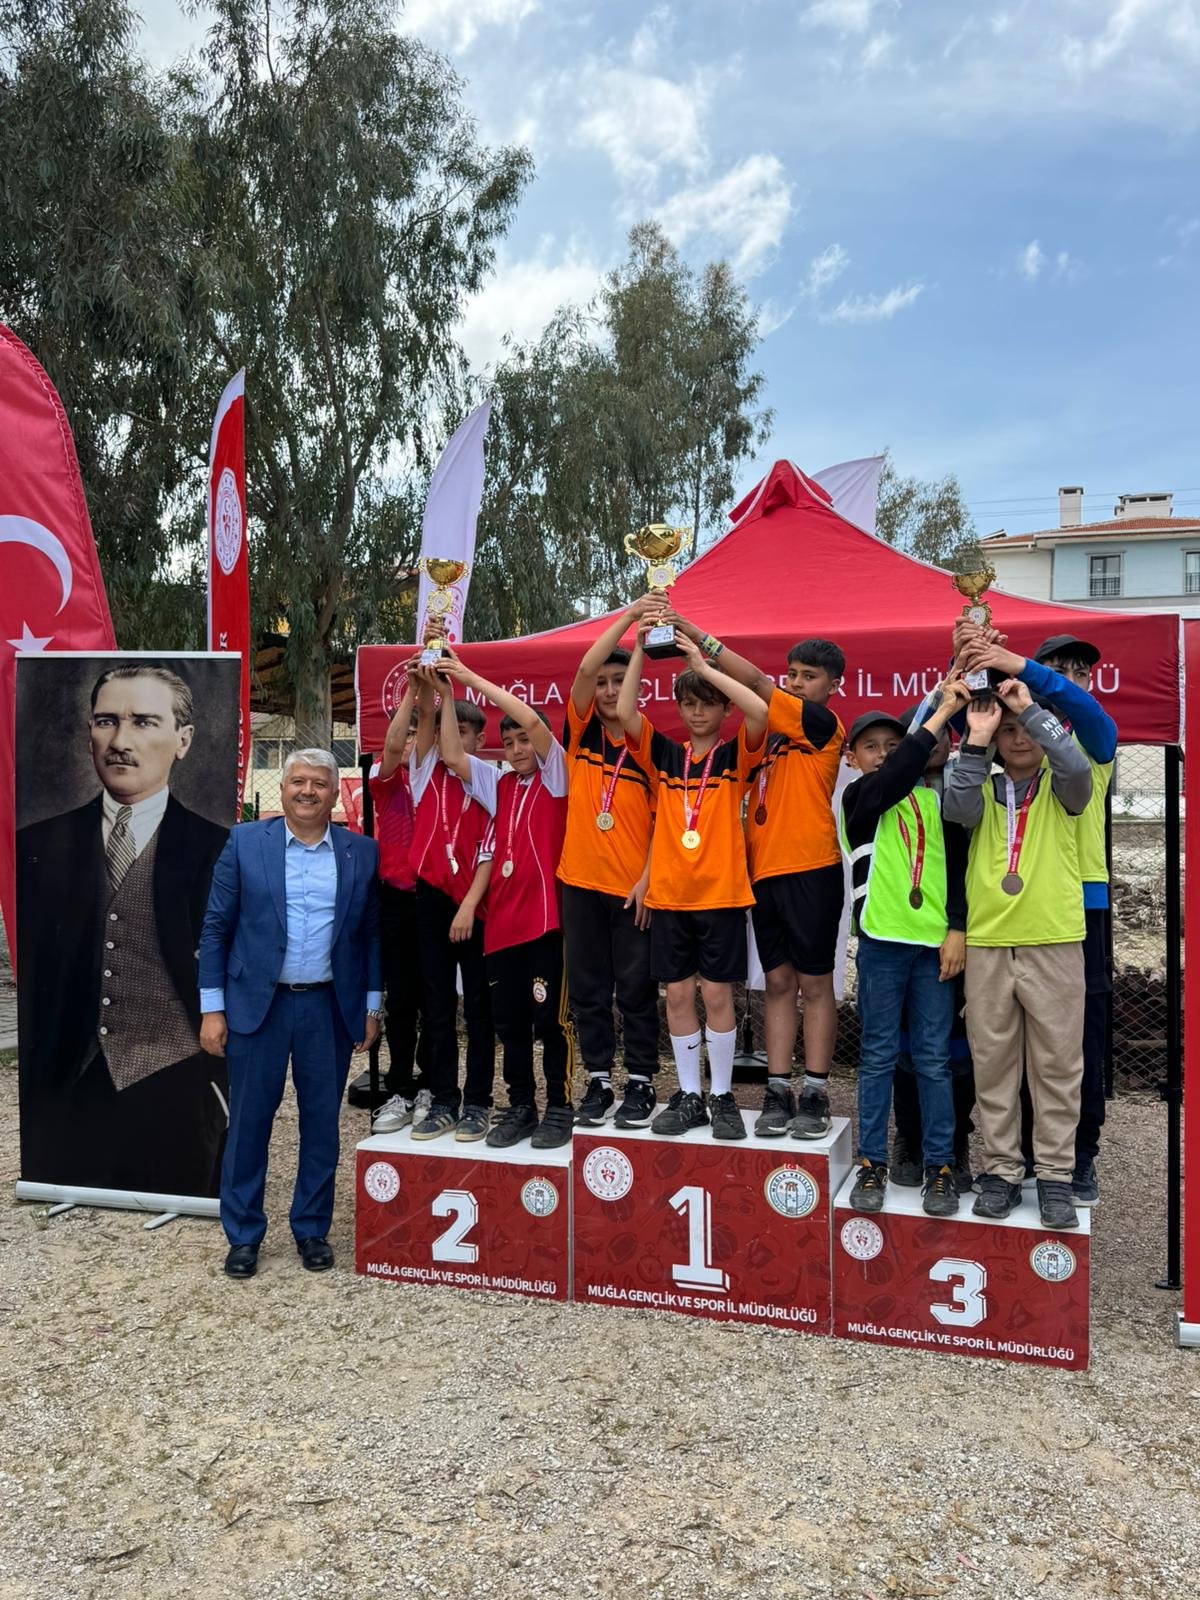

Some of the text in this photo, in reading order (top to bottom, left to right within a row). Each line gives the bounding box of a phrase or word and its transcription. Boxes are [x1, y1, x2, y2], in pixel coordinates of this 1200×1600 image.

[857, 669, 883, 698] İL
[431, 1188, 479, 1264] 2
[668, 1185, 731, 1293] 1
[367, 1262, 557, 1294] MUĞLA GENÇLİK VE SPOR İL MÜDÜRLÜĞÜ
[928, 1256, 987, 1328] 3
[588, 1284, 817, 1323] MUĞLA GENÇLİK VE SPOR İL MÜDÜRLÜĞÜ
[848, 1322, 1075, 1361] MUĞLA GENÇLİK VE SPOR İL MÜDÜRLÜĞÜ
